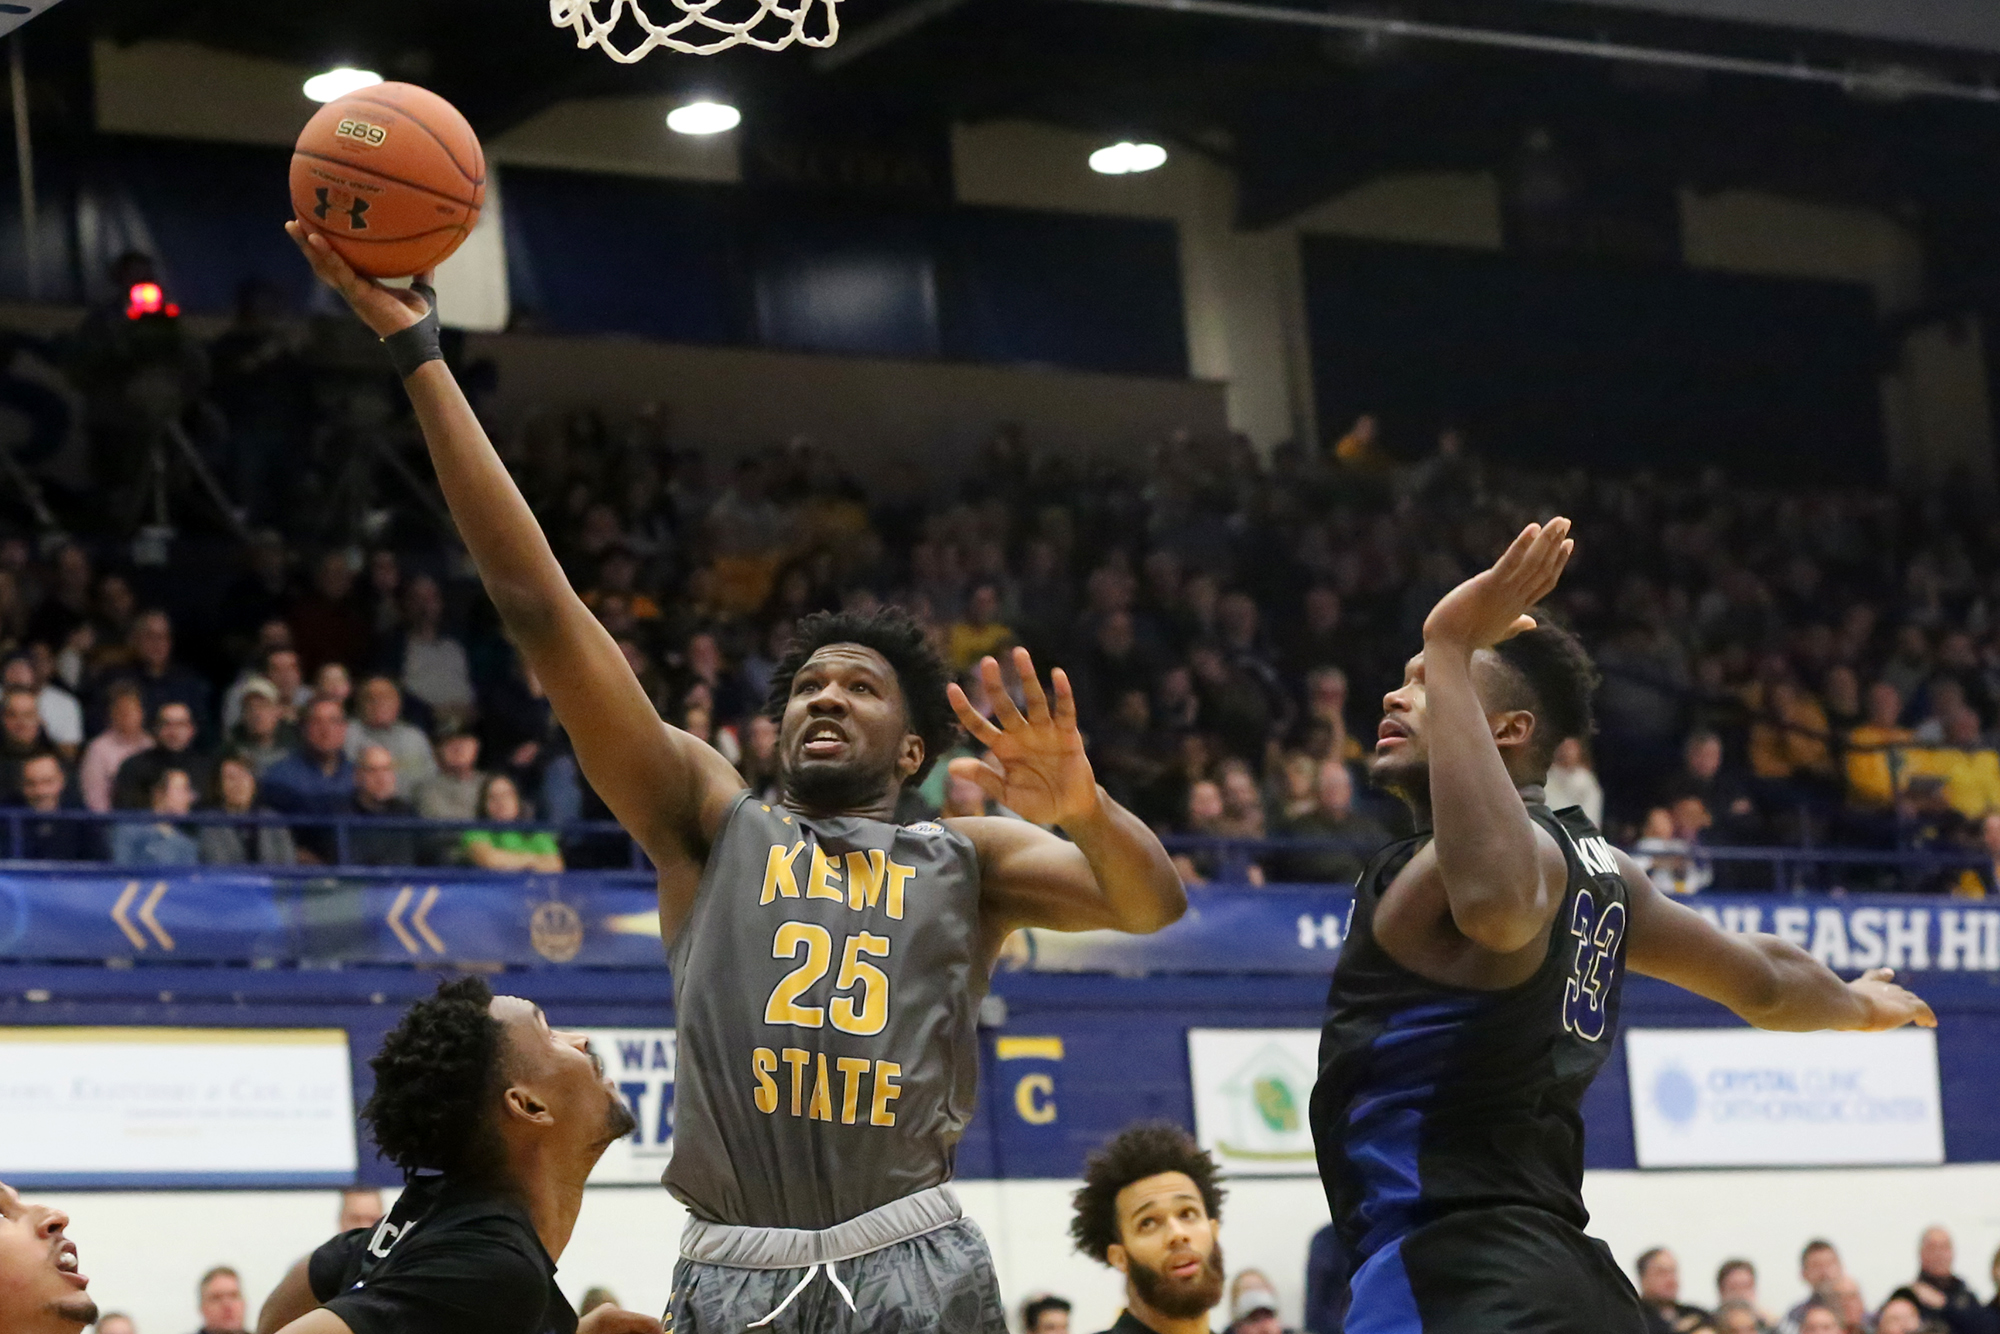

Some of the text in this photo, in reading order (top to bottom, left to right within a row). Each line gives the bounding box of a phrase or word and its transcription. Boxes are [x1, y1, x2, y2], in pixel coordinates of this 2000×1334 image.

[758, 839, 917, 920] KENT
[1572, 835, 1621, 877] KIN
[764, 920, 891, 1037] 25
[1563, 888, 1627, 1042] 33
[617, 1040, 677, 1070] WA
[752, 1046, 902, 1127] STATE
